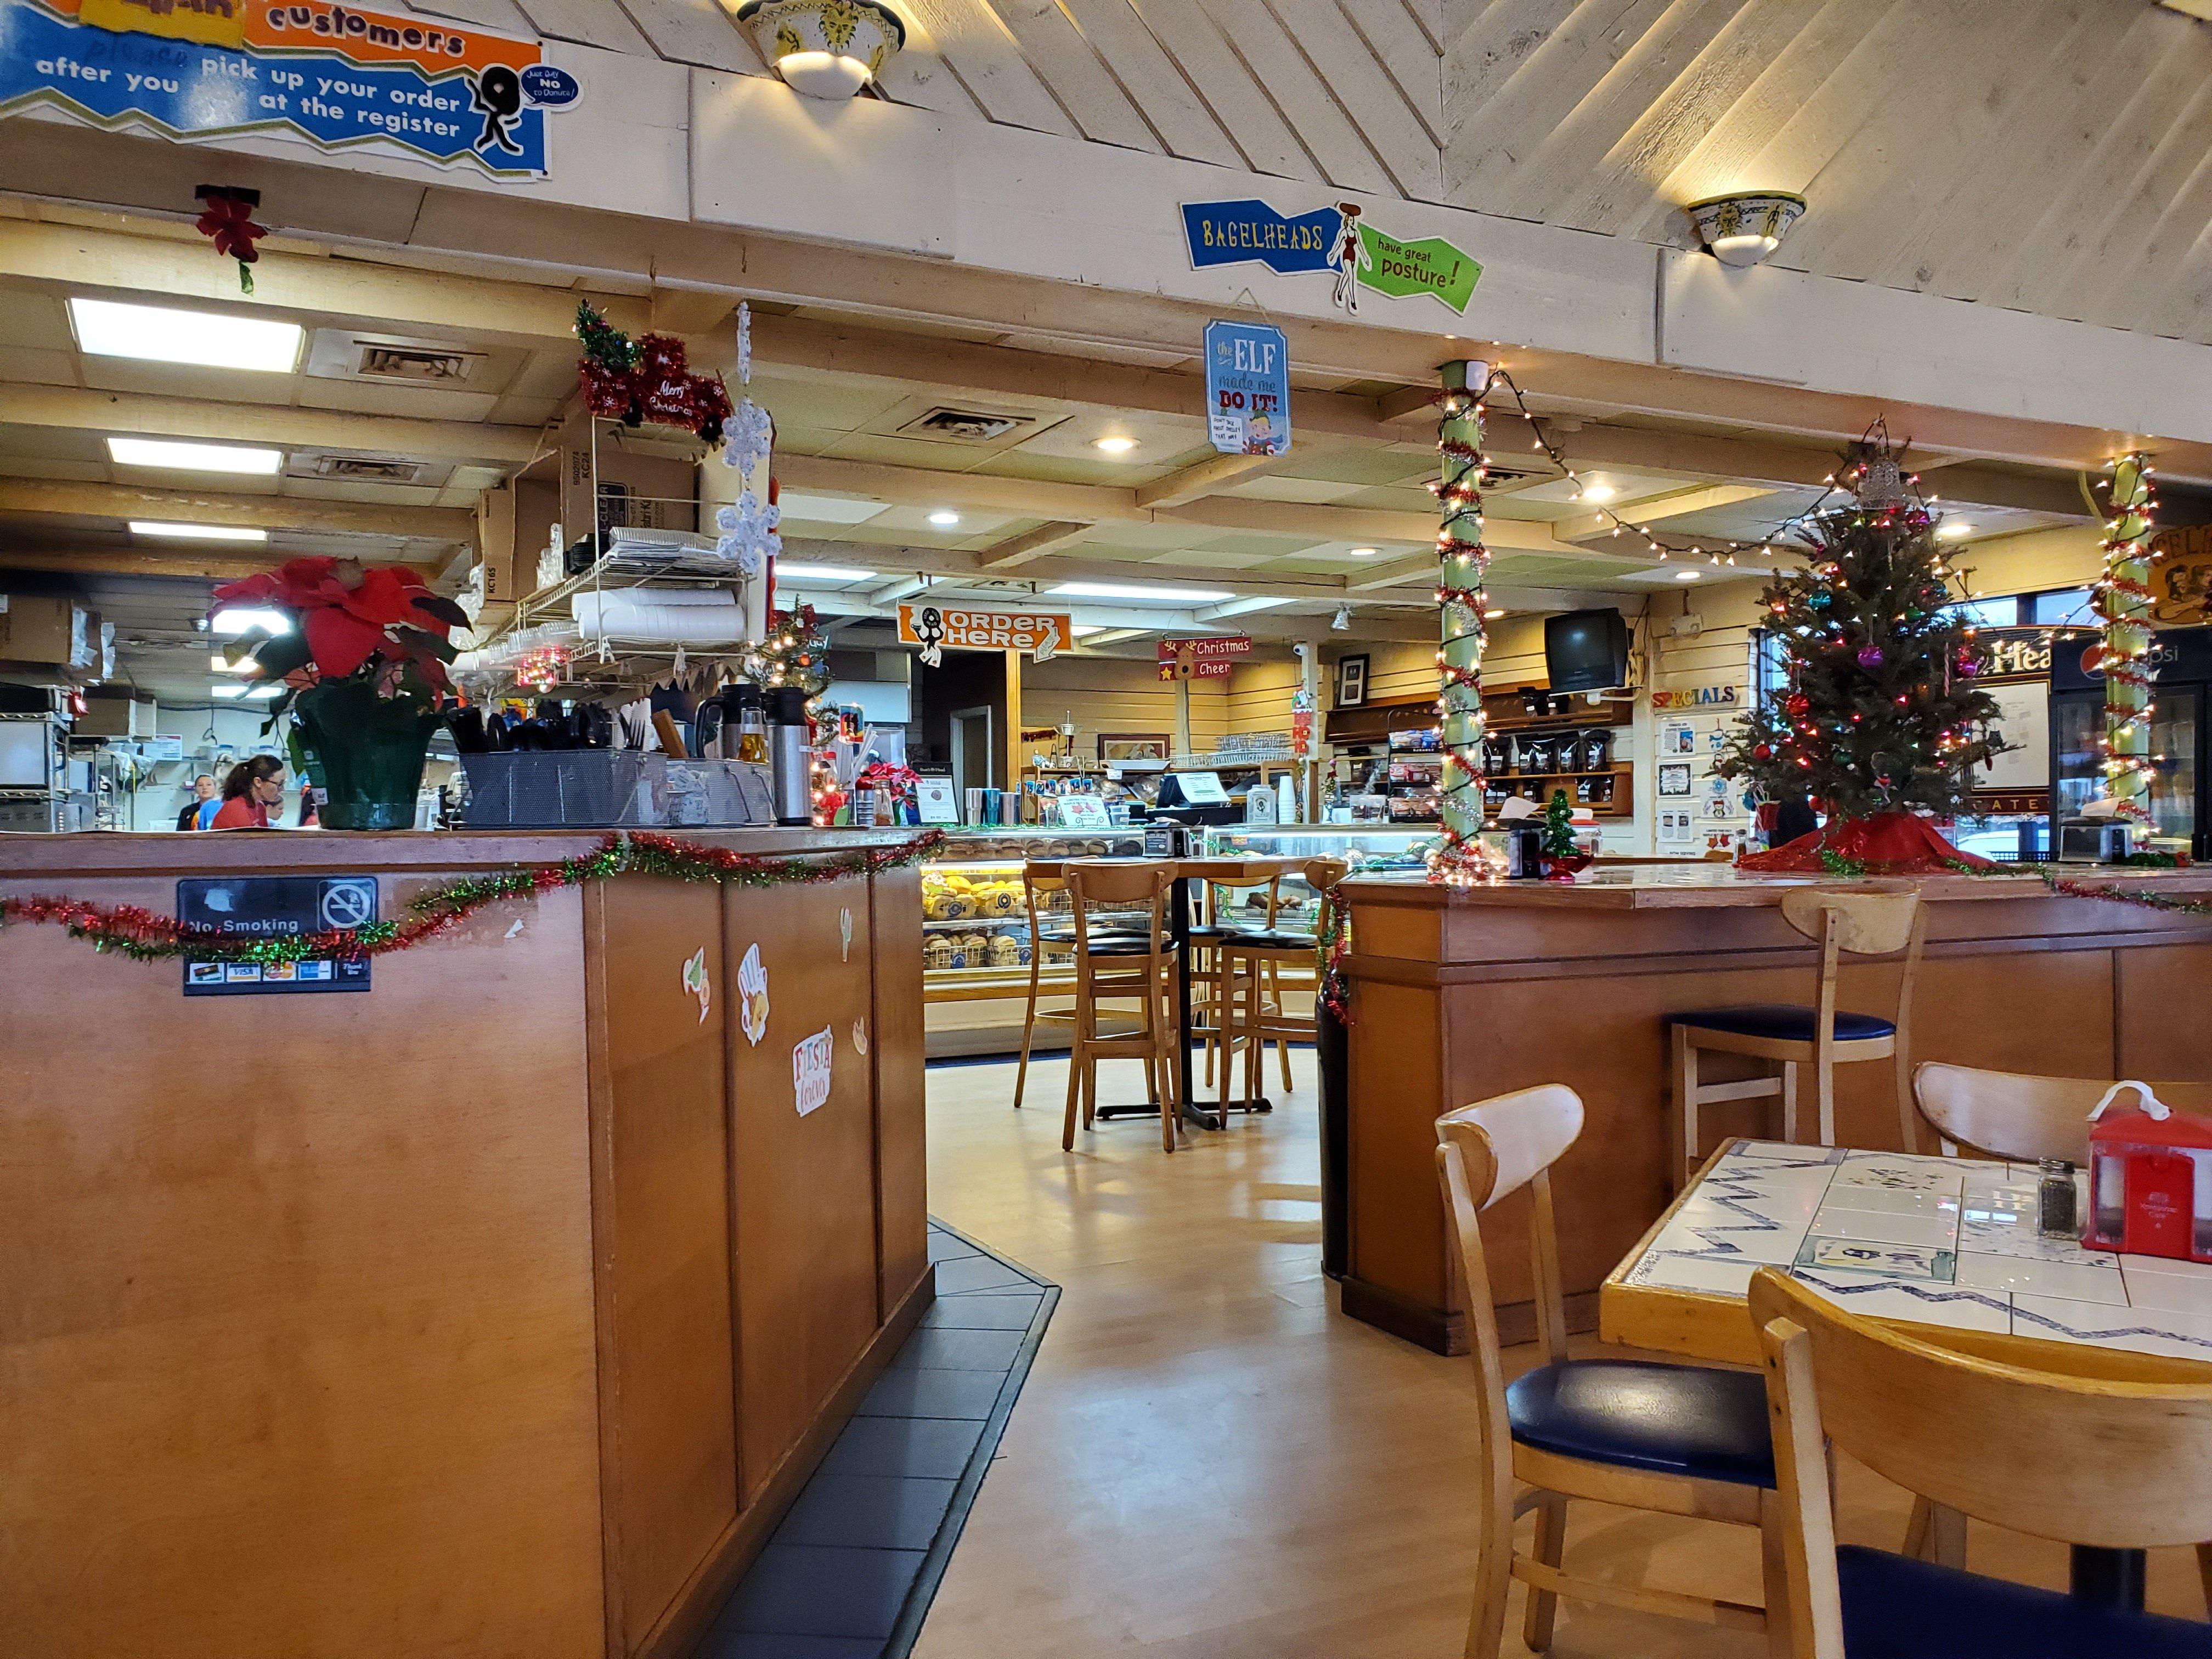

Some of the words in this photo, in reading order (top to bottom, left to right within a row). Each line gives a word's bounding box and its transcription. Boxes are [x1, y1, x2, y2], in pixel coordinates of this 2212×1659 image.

[268, 6, 465, 56] customers
[36, 57, 111, 82] after
[125, 72, 179, 93] you
[201, 55, 258, 80] pick
[271, 69, 304, 91] up
[317, 76, 377, 99] your
[390, 89, 460, 112] order
[539, 78, 561, 88] NO
[259, 92, 288, 110] at
[301, 97, 345, 120] the
[358, 110, 460, 138] register
[1203, 220, 1323, 250] BAGELHEADS
[1378, 238, 1402, 256] have
[1404, 249, 1432, 264] great
[1216, 340, 1233, 357] the
[1234, 338, 1277, 374] ELF
[660, 380, 685, 399] Merry
[1218, 371, 1254, 391] made
[1257, 379, 1276, 393] me
[1218, 390, 1245, 409] DO
[1251, 394, 1278, 412] IT!
[582, 453, 590, 478] KC24
[1197, 640, 1250, 655] Christmas
[1199, 662, 1231, 675] Cheer
[1652, 686, 1735, 708] SPECIALS
[189, 922, 212, 933] No
[223, 919, 298, 933] Smoking
[795, 1039, 832, 1083] FIESTA
